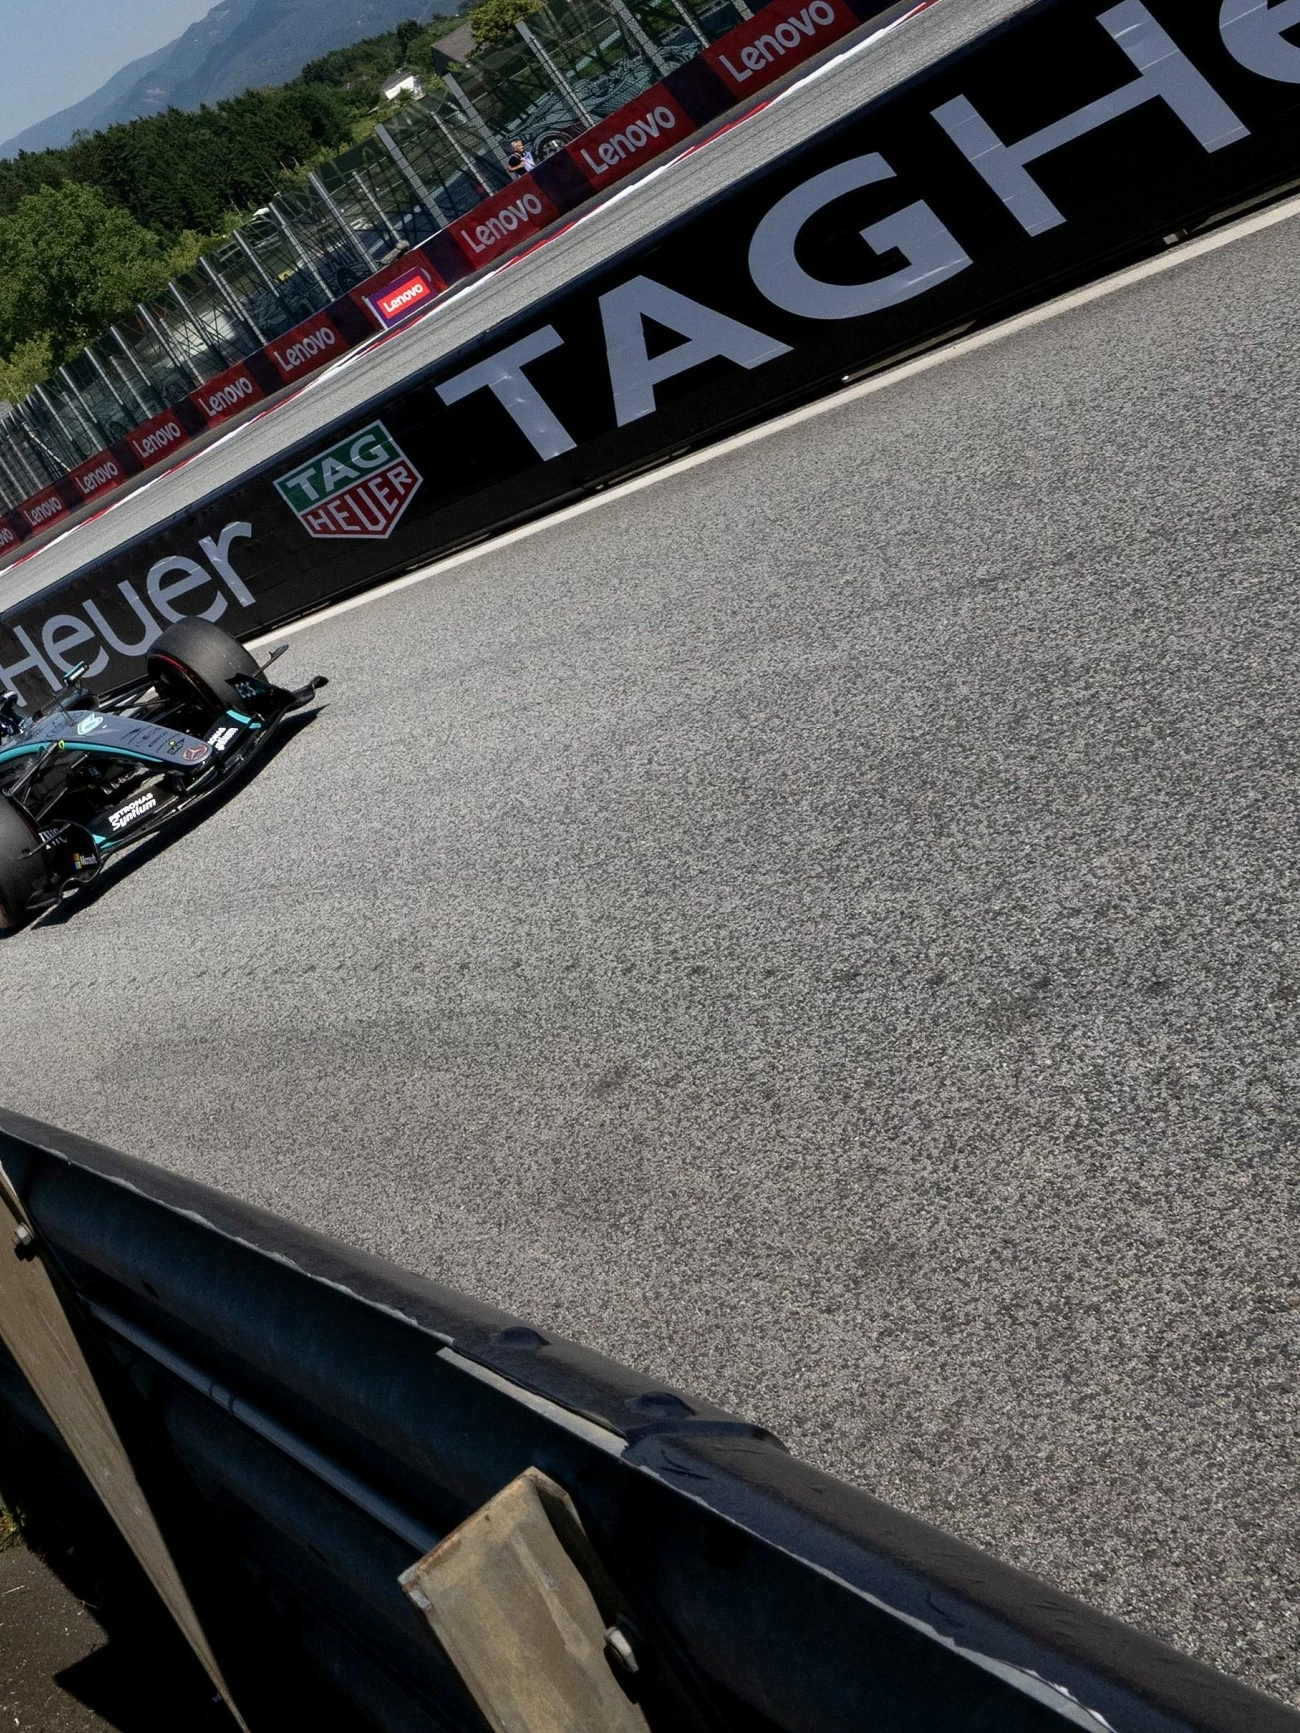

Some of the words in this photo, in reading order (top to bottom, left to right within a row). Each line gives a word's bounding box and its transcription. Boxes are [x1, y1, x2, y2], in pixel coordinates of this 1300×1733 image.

[718, 0, 835, 83] Lenovo
[580, 105, 676, 175] Lenovo
[460, 193, 543, 254] Lenovo
[383, 283, 424, 313] Lenovo
[273, 327, 336, 372] Lenovo
[198, 377, 253, 418] Lenovo
[132, 421, 181, 459] Lenovo
[75, 461, 119, 495] Lenovo
[286, 434, 390, 501] TAG
[25, 496, 62, 526] Lenovo
[307, 465, 413, 531] HEUER
[108, 792, 154, 823] PETRONAS
[111, 798, 157, 831] Syntium
